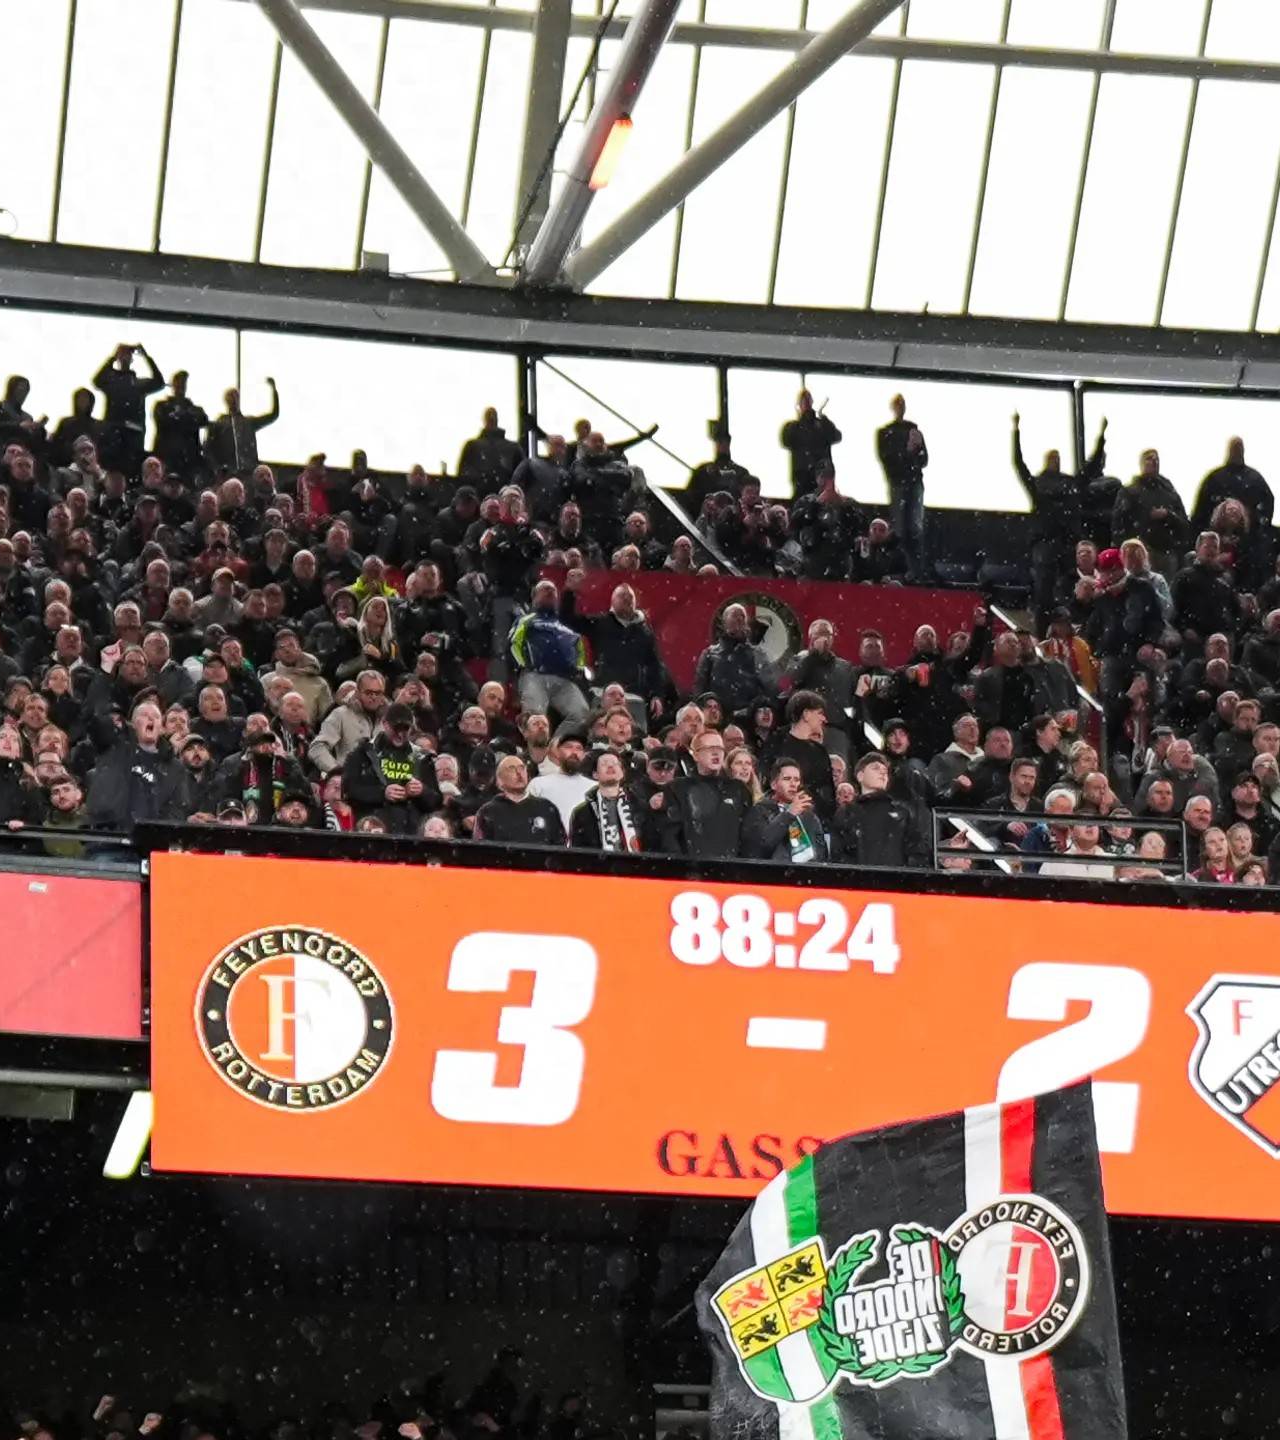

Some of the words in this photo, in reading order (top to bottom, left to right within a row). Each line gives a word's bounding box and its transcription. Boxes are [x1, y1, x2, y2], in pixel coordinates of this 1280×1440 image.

[212, 932, 379, 997] FEYENOORD
[669, 891, 902, 974] 88:24
[431, 931, 598, 1126] 3
[996, 961, 1152, 1154] 2
[1233, 1000, 1253, 1036] F
[211, 1042, 381, 1105] ROTTERDAM
